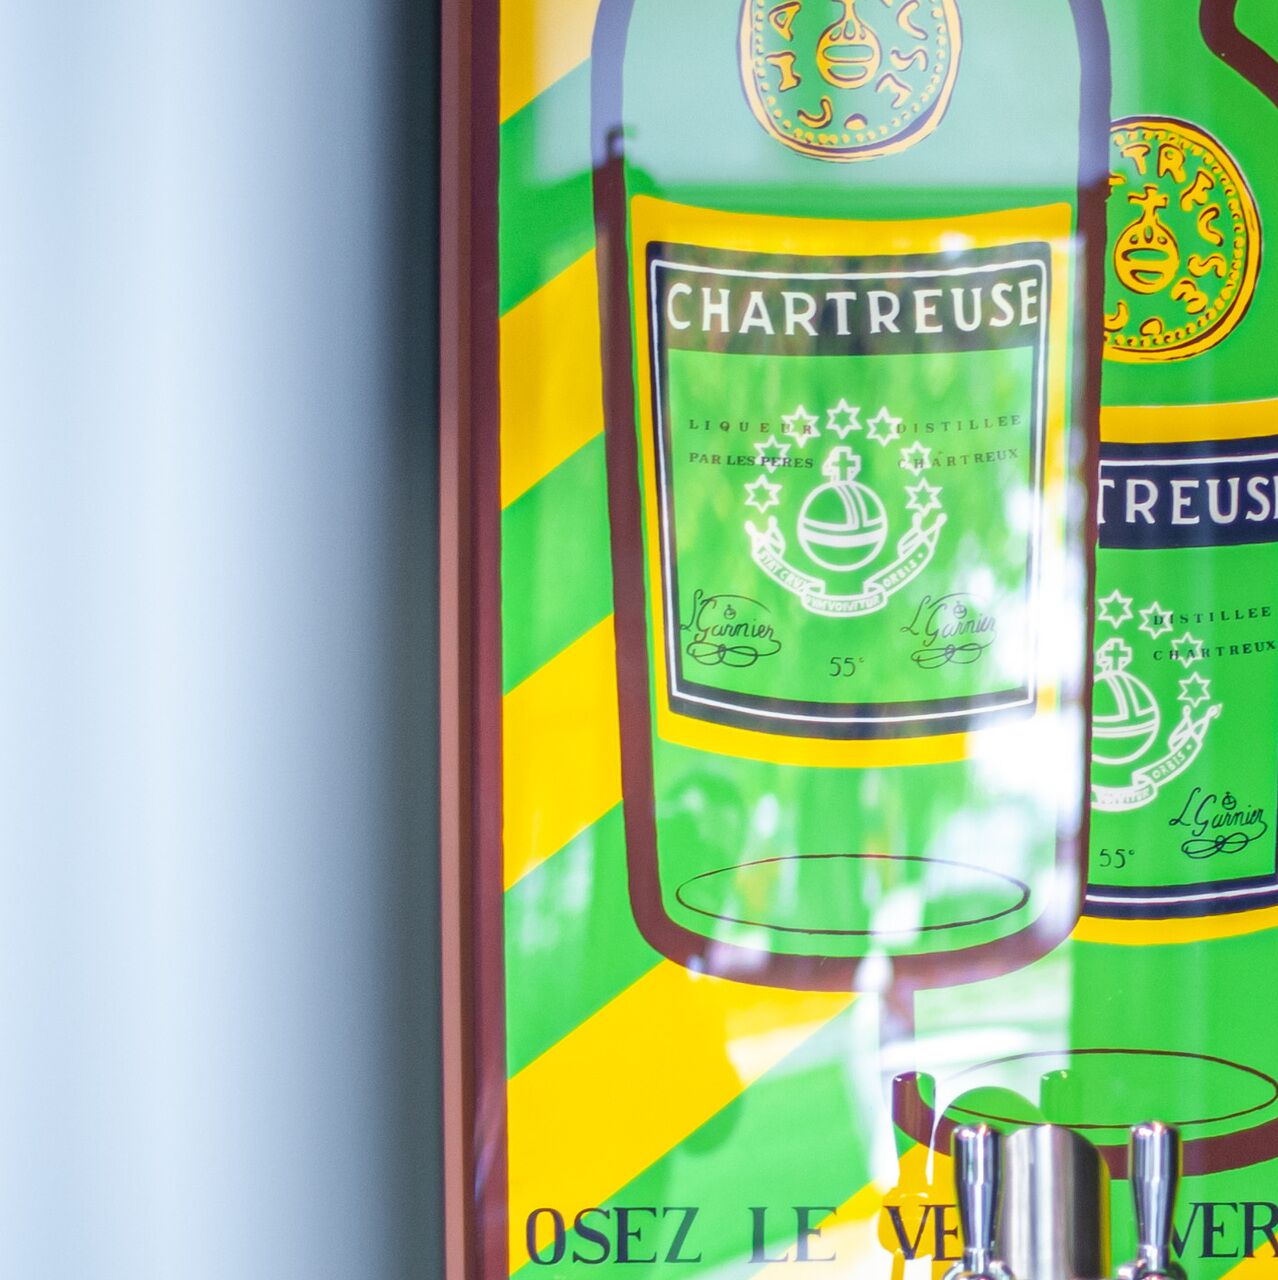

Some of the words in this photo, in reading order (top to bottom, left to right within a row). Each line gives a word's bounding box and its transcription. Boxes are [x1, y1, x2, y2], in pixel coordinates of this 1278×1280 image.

[667, 278, 1039, 336] CHARTREUSE
[688, 419, 812, 435] LIQUEUR
[895, 414, 1022, 434] DISTILLEE
[688, 452, 721, 465] PAR
[727, 455, 756, 466] LES
[1153, 606, 1272, 626] DISTILLEE
[1152, 640, 1277, 661] CHARTREUX
[1099, 848, 1135, 868] 55°
[525, 1206, 703, 1265] OSEZ
[747, 1205, 838, 1263] LE
[882, 1204, 963, 1262] VE
